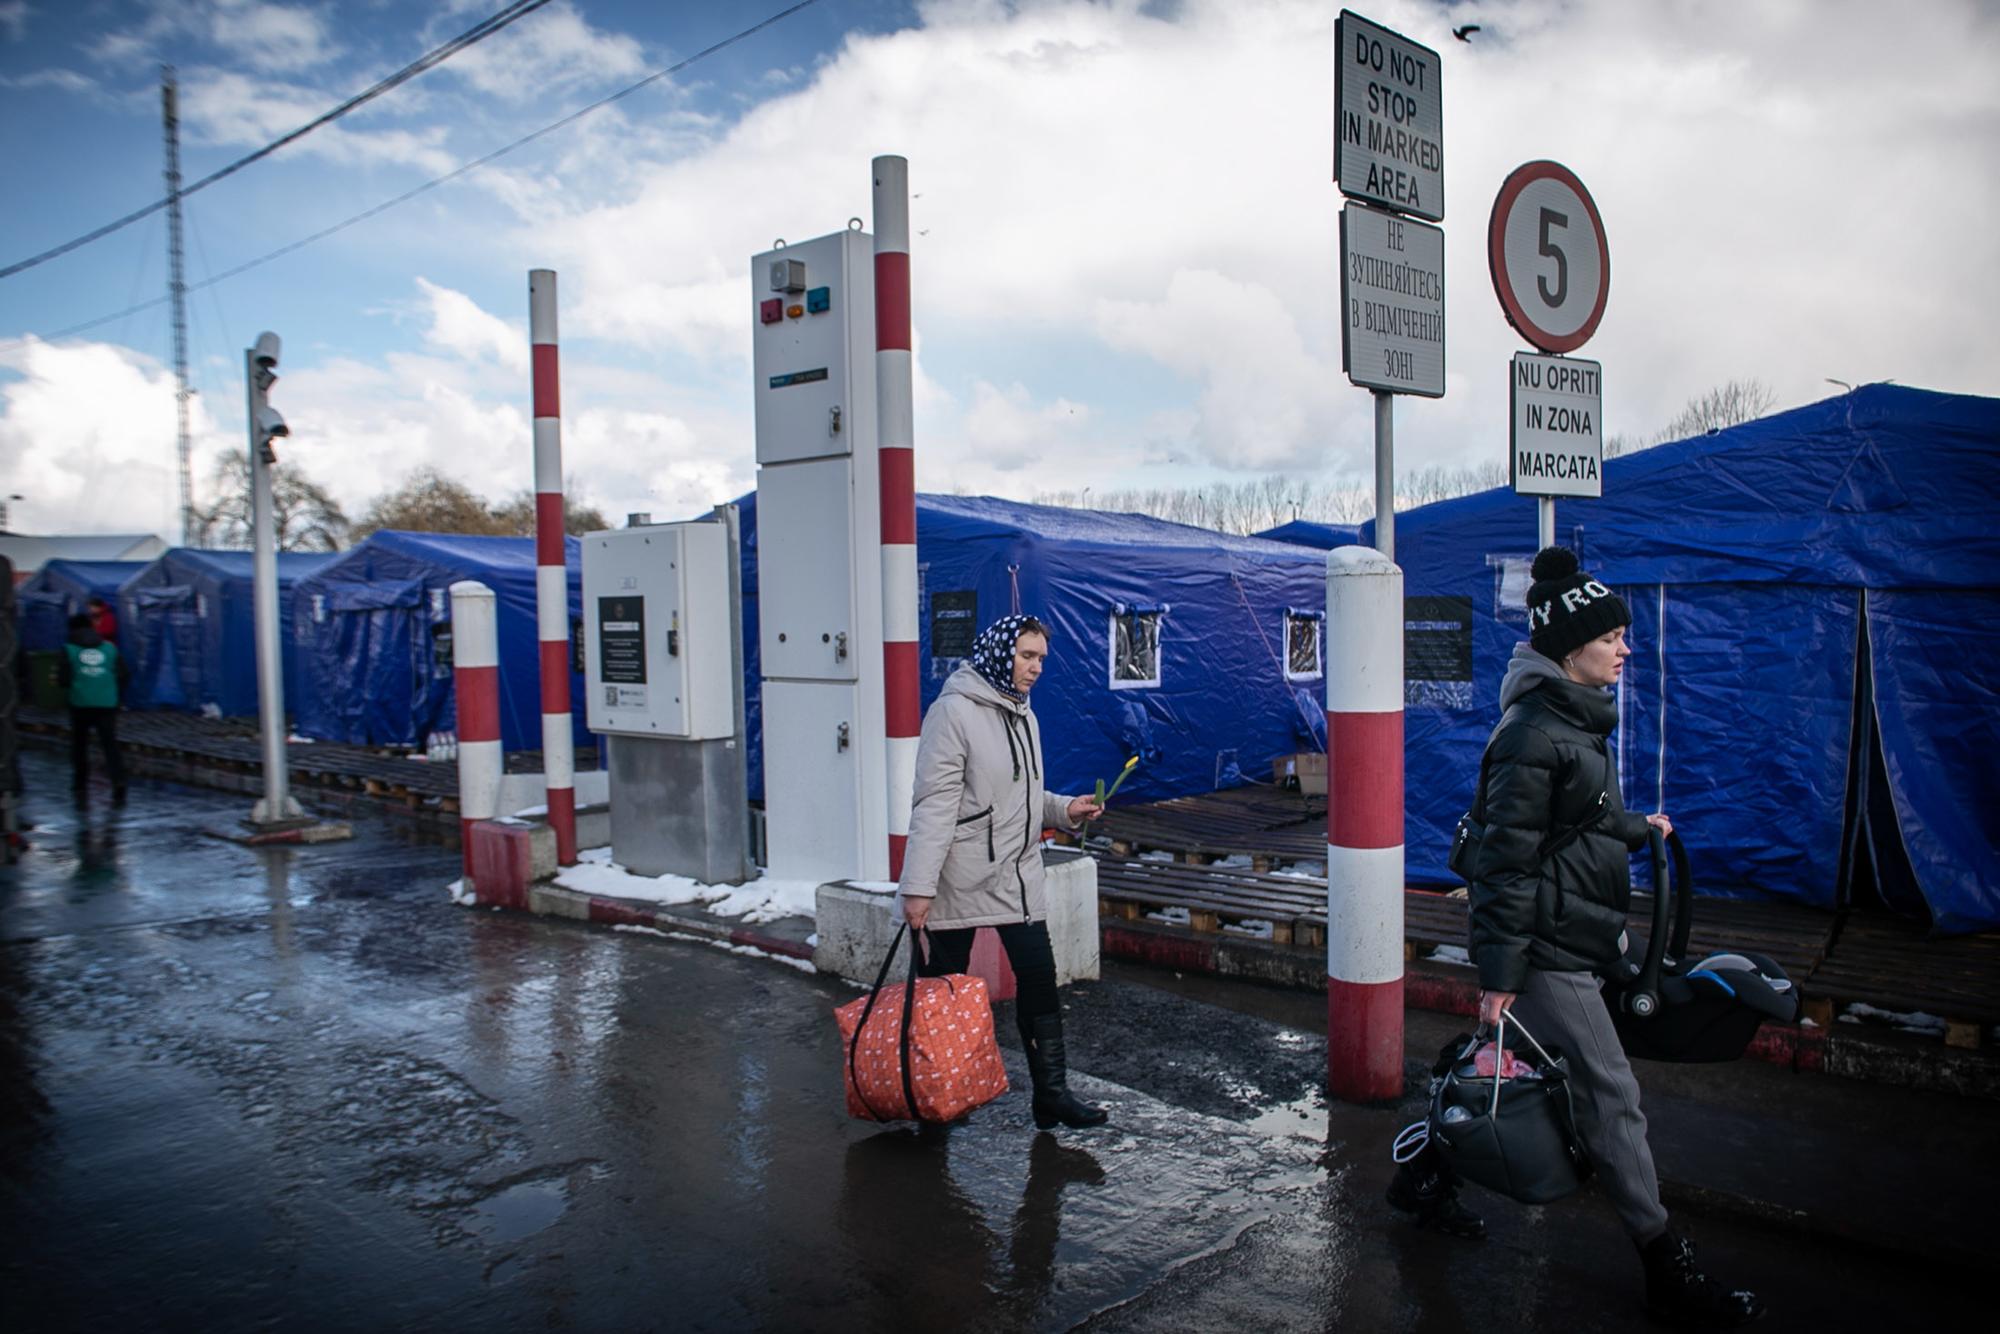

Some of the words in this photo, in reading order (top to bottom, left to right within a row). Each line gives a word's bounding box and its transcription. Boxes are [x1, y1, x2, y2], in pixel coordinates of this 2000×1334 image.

[1357, 32, 1383, 72] DO
[1390, 47, 1426, 91] NOT
[1368, 81, 1416, 127] STOP
[1343, 110, 1361, 146] IN
[1368, 119, 1440, 172] MARKED
[1366, 162, 1420, 207] AREA
[1387, 219, 1405, 252] НЕ
[1537, 206, 1569, 309] 5
[1350, 251, 1441, 302] ЗУПИНЯЙТЕСЬ
[1352, 298, 1360, 328] В
[1365, 301, 1441, 343] ВІДМІЧЕНІЙ
[1384, 348, 1414, 381] ЗОНІ
[1518, 361, 1541, 388] NU
[1547, 366, 1599, 396] OPRITI
[1526, 403, 1542, 430] IN
[1548, 407, 1592, 436] ZONA
[1519, 451, 1598, 481] MARCATA
